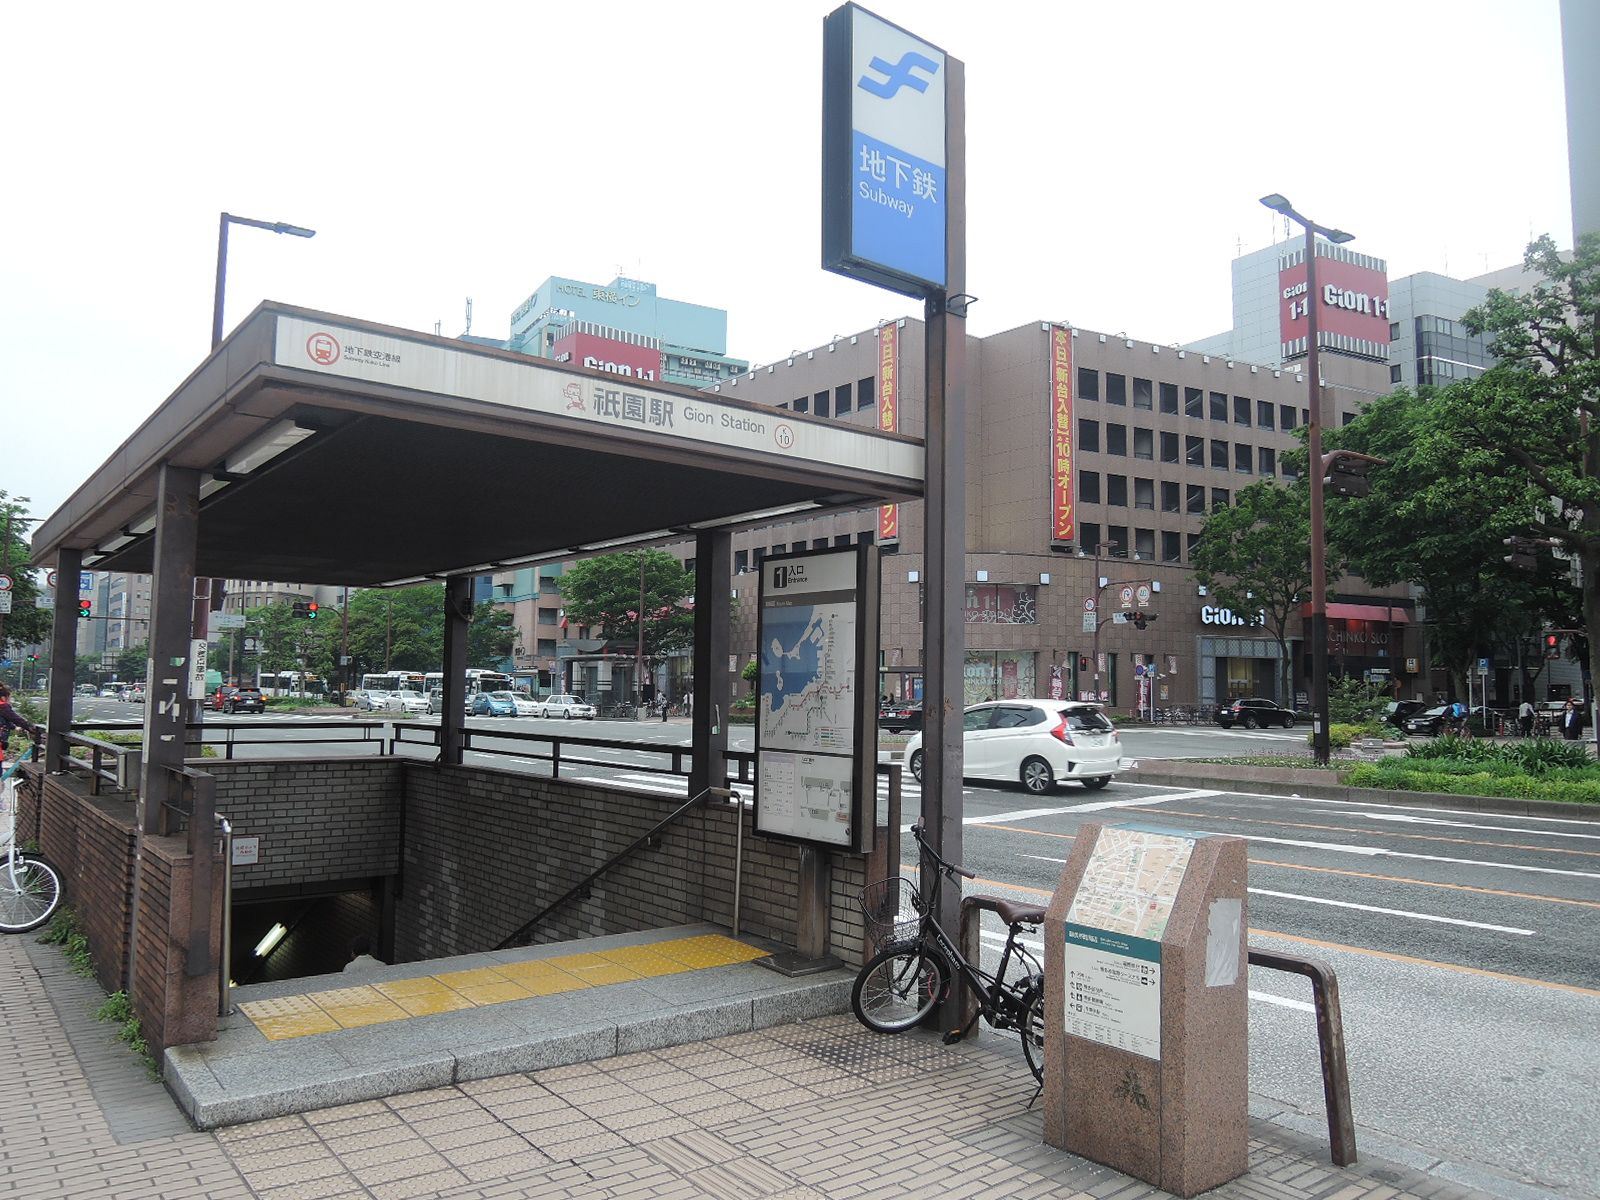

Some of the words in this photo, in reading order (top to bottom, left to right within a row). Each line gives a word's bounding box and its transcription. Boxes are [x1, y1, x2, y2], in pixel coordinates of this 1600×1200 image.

[859, 144, 937, 204] 地下鉄
[859, 181, 915, 218] Subway
[556, 285, 588, 299] HOTEL
[592, 288, 641, 308] 東横イン
[1324, 284, 1371, 313] Gion
[344, 345, 401, 363] 地下鉄空港線
[344, 355, 364, 364] Subway
[593, 387, 674, 429] 祇園駅
[684, 406, 714, 425] Gion
[721, 413, 765, 435] Station
[779, 434, 790, 445] 10
[776, 567, 784, 588] 1
[788, 565, 804, 577] 入口
